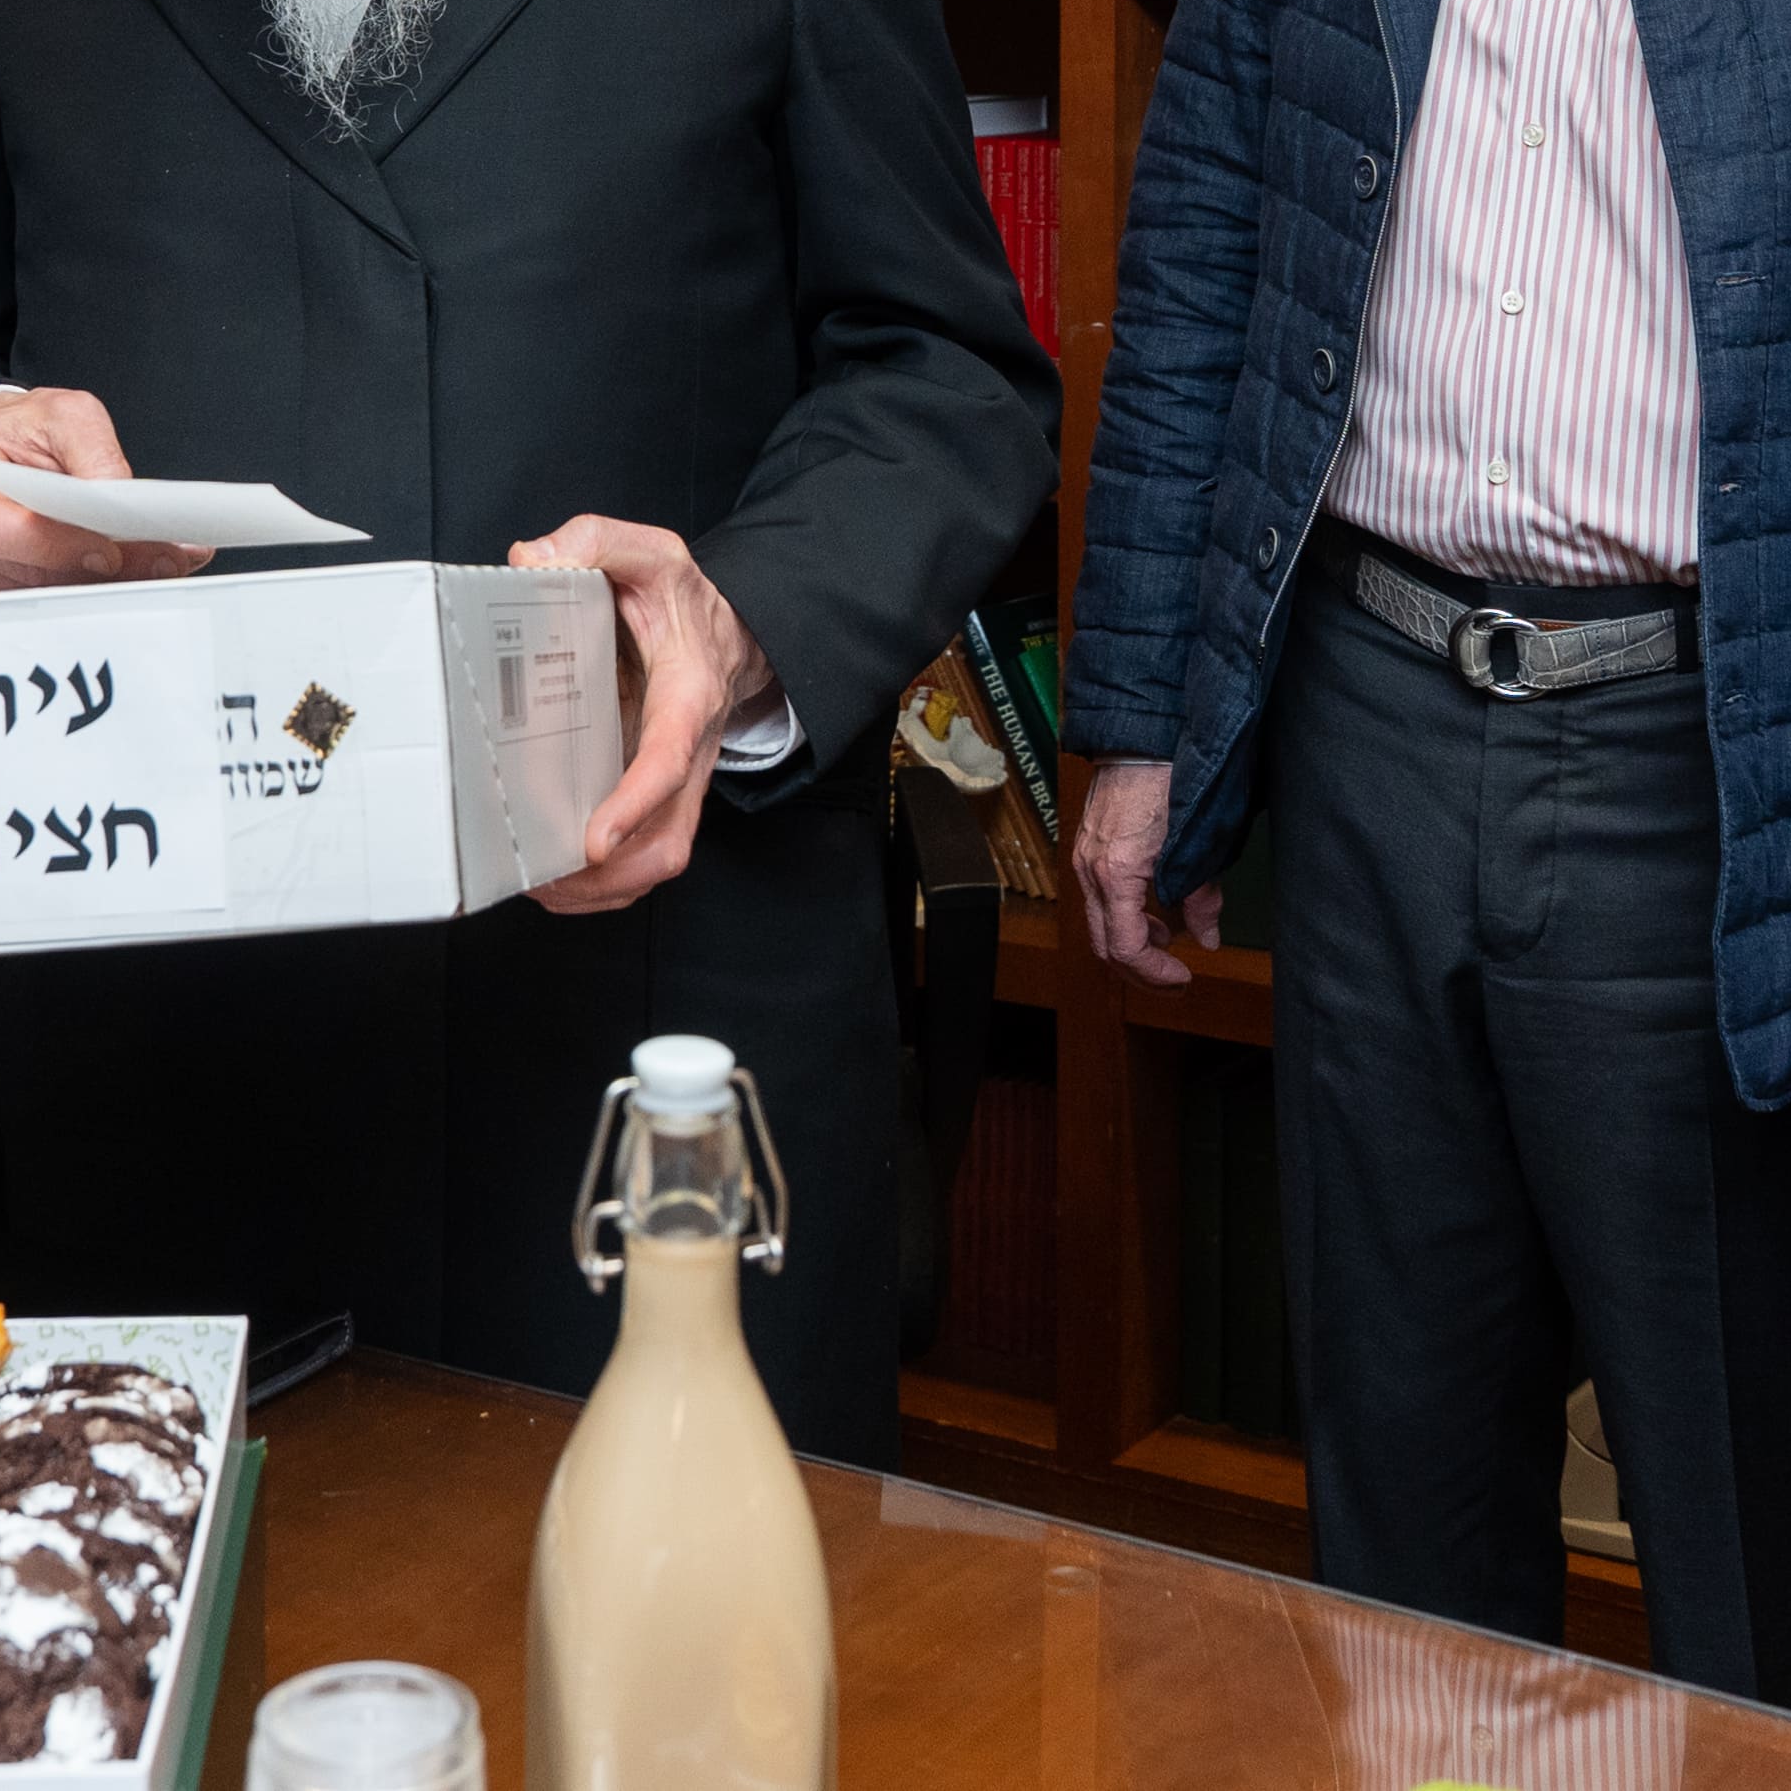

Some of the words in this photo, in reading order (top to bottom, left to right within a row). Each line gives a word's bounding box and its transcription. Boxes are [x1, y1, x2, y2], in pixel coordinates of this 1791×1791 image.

[215, 693, 257, 743] ה
[980, 660, 1008, 702] THE
[997, 700, 1040, 778] HUMAN
